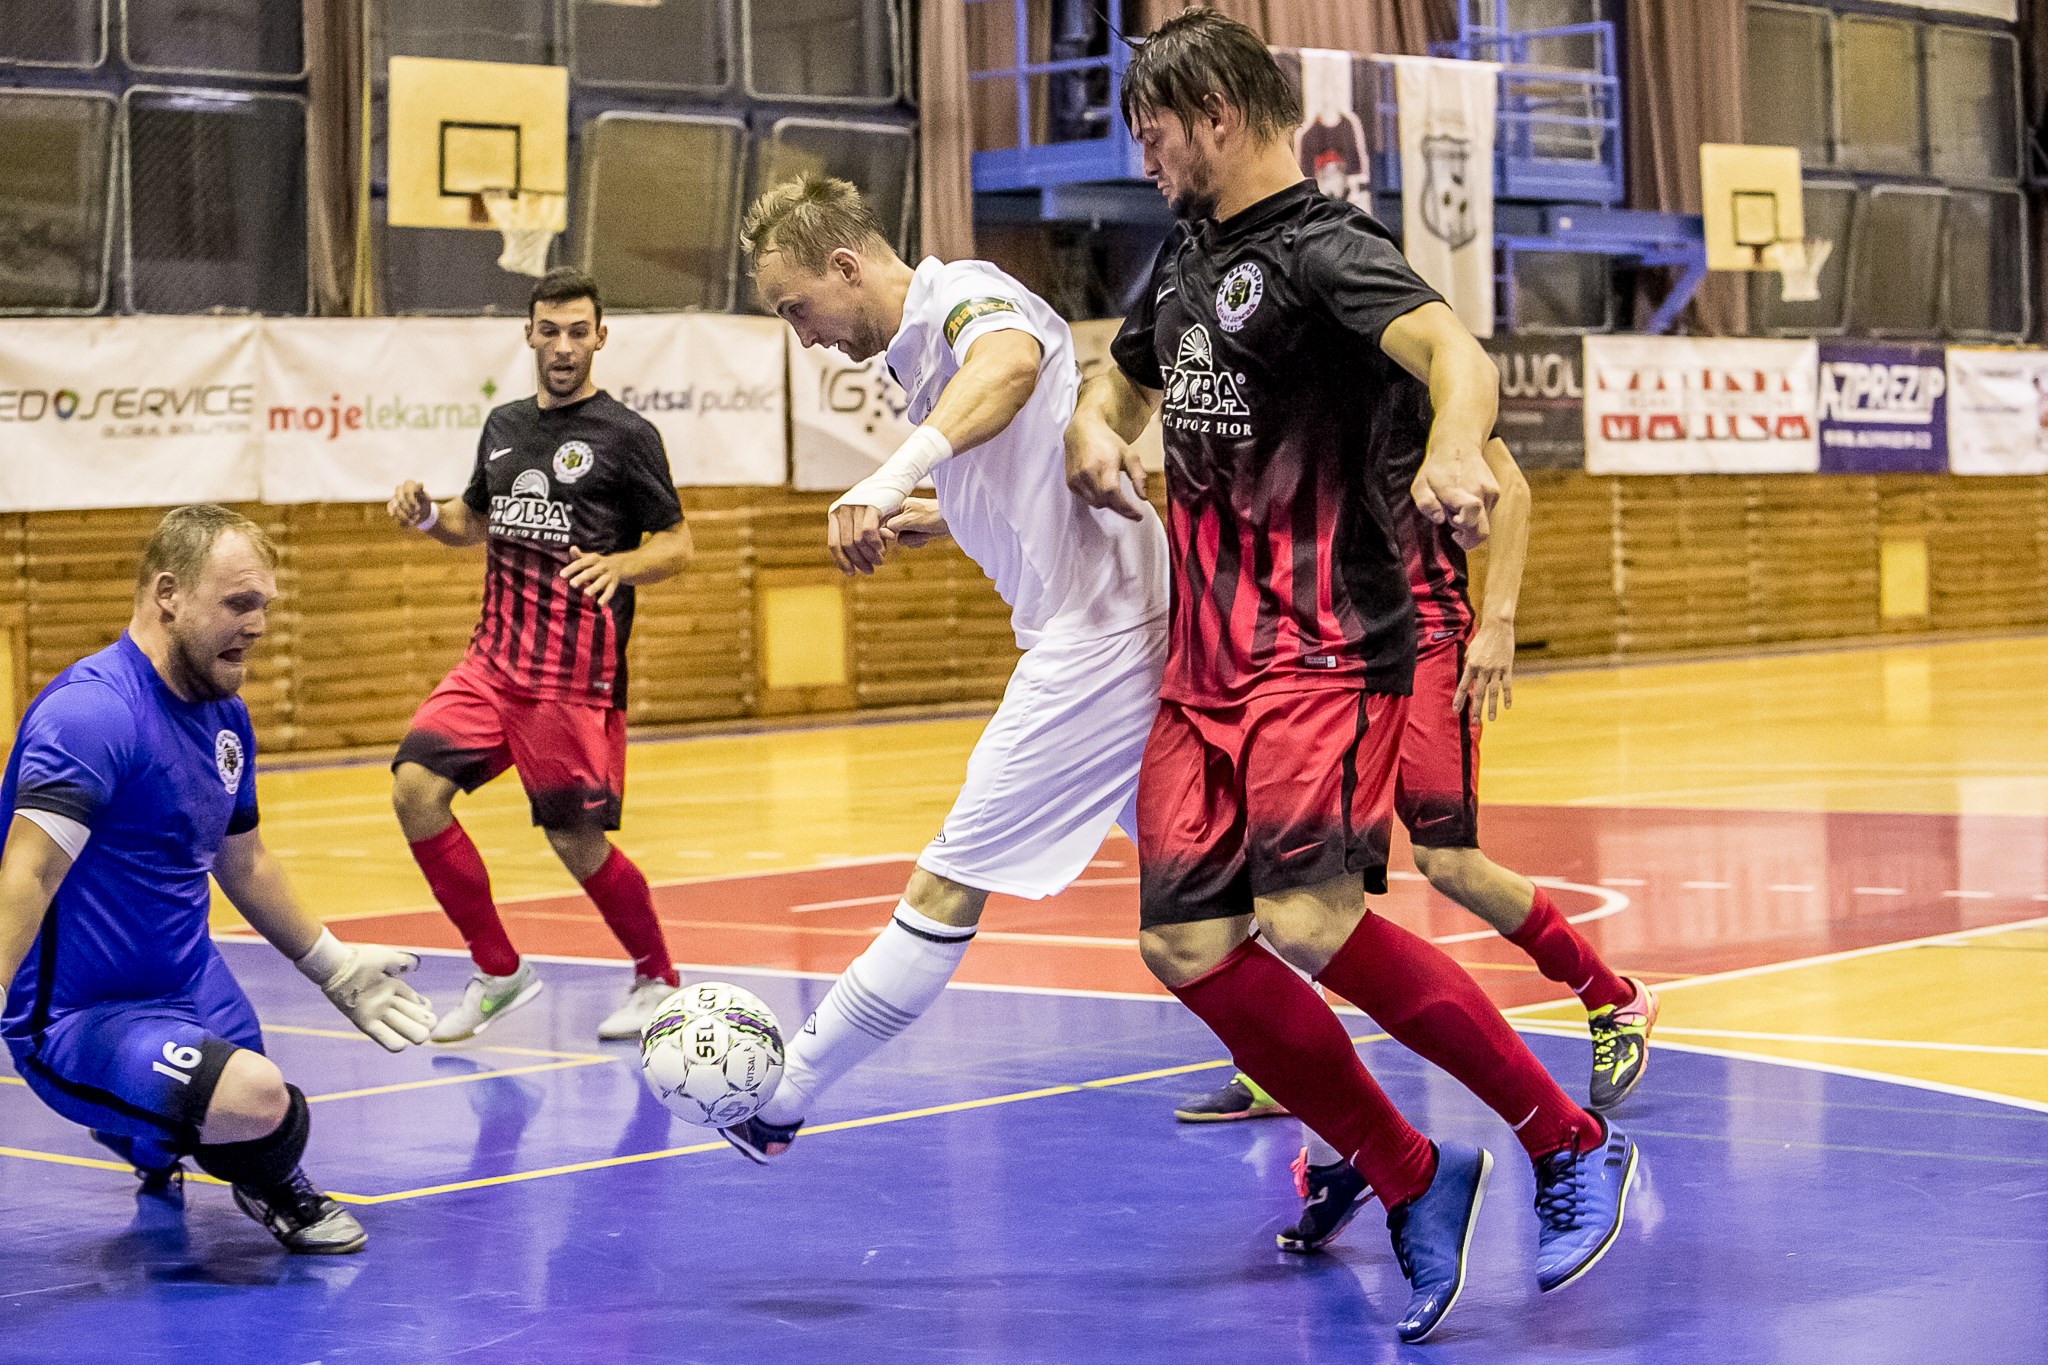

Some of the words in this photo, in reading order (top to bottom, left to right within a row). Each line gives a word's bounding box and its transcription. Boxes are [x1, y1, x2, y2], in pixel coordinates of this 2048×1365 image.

[1216, 422, 1252, 436] HOR
[490, 496, 570, 531] HOLBA
[152, 1041, 203, 1085] 16
[745, 1054, 756, 1087] FUTSAL
